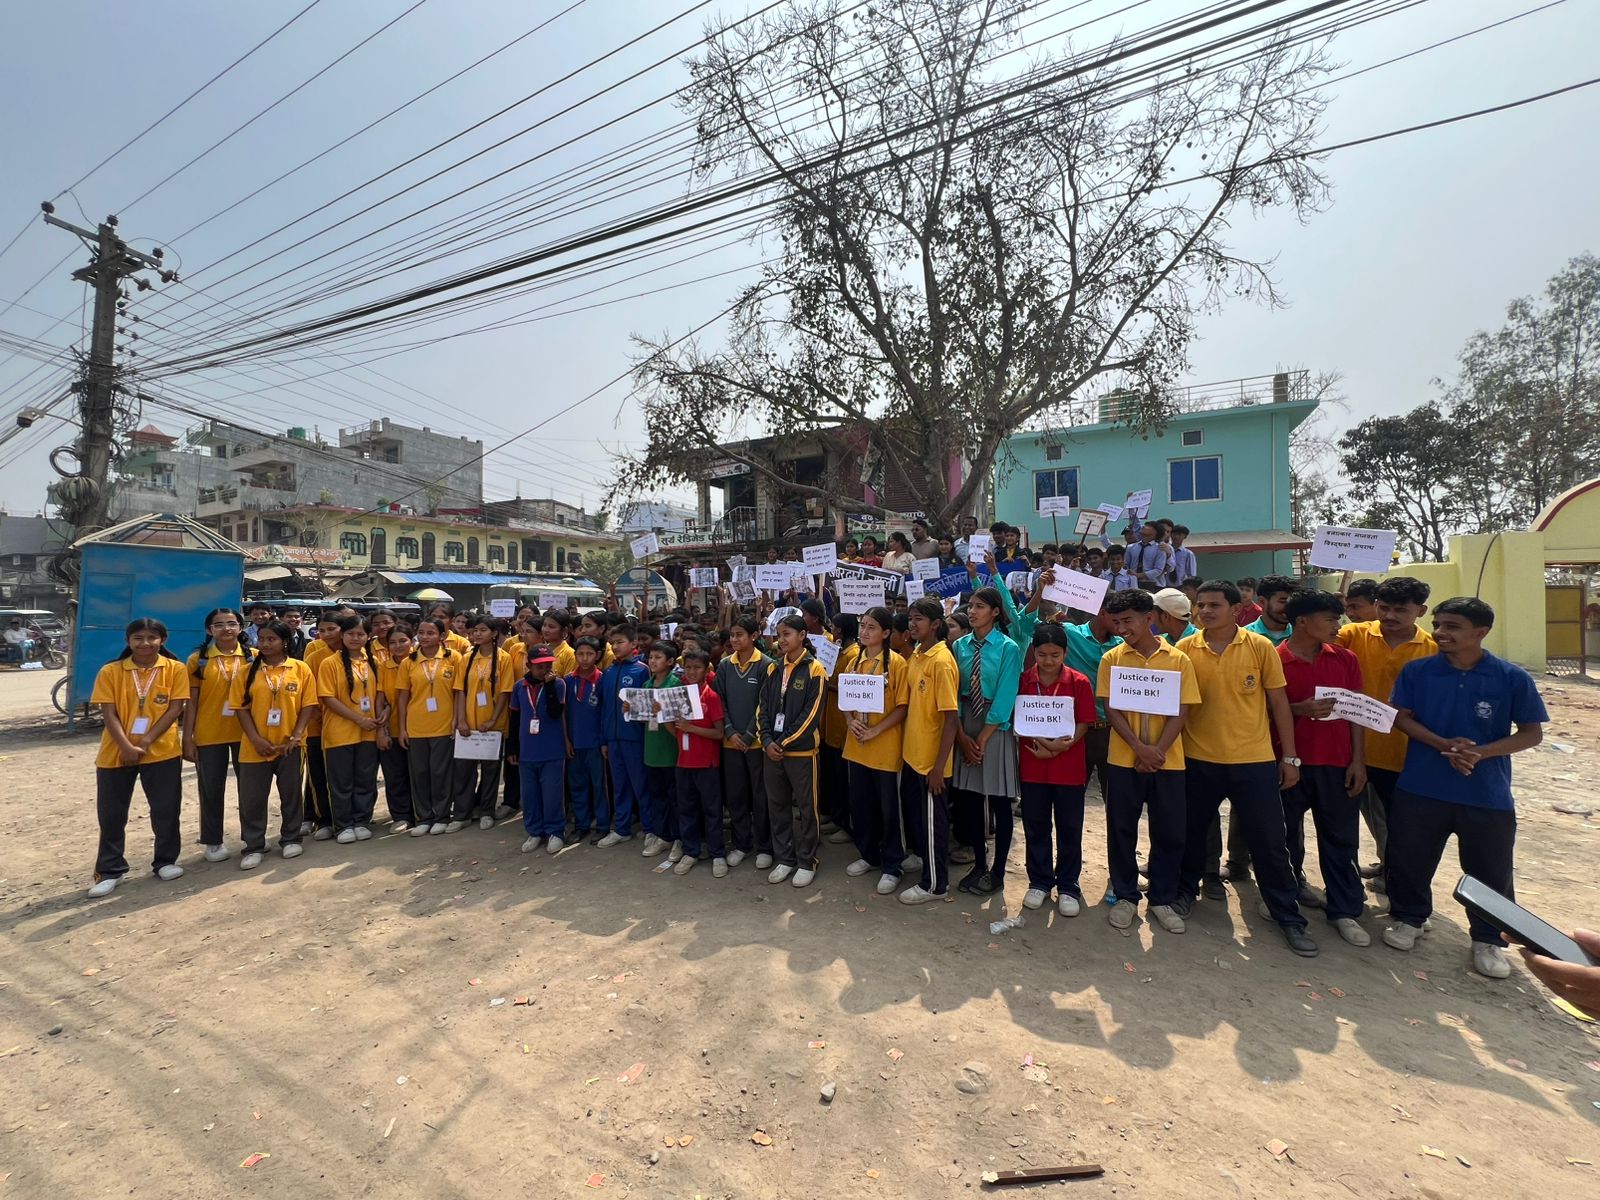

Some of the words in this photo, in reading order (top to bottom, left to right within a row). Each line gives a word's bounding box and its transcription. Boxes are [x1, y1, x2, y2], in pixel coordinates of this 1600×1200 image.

[1326, 530, 1352, 538] बलात्कार
[843, 678, 865, 686] Justice
[1118, 672, 1149, 682] Justice
[1151, 674, 1165, 683] for
[846, 691, 861, 699] Inisa
[862, 692, 873, 700] BK!
[1120, 686, 1142, 696] Inisa
[1144, 689, 1160, 698] BK!
[1022, 700, 1050, 709] Justice
[1052, 701, 1064, 709] for
[1025, 714, 1044, 723] Inisa
[1046, 715, 1062, 723] BK!
